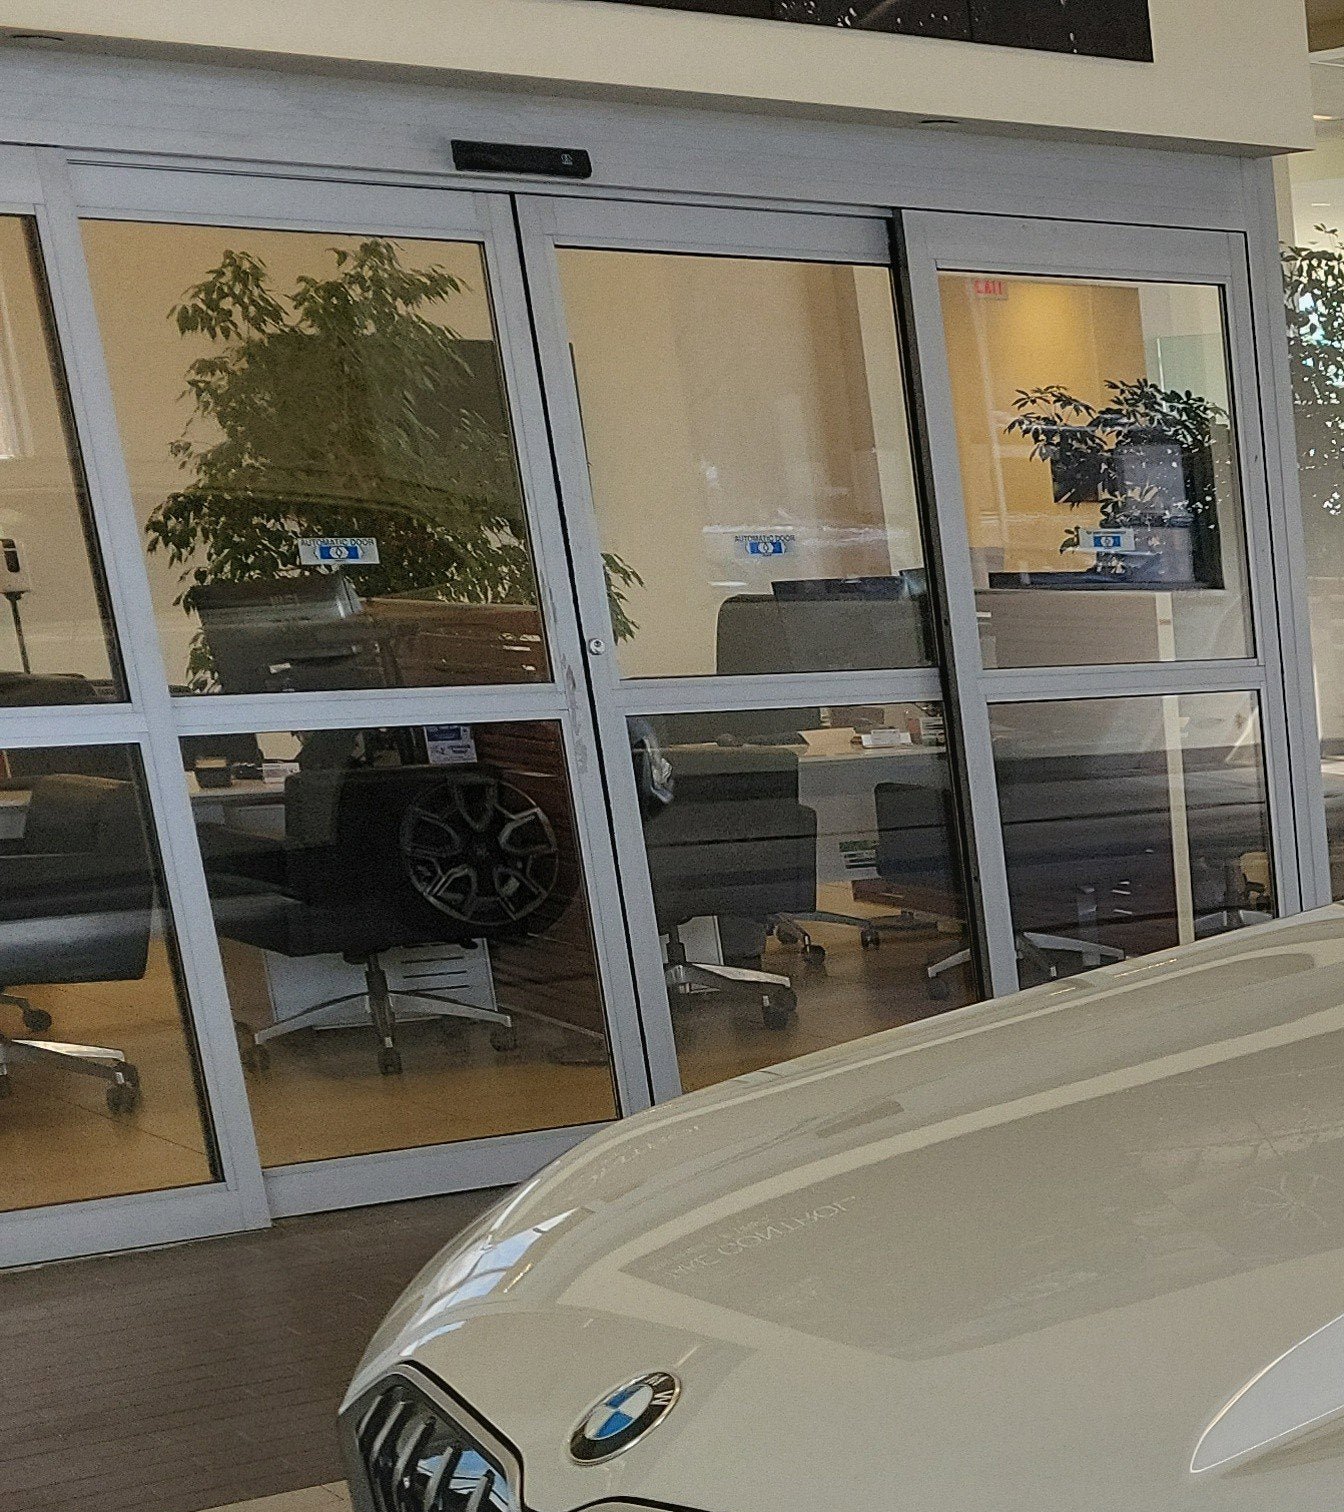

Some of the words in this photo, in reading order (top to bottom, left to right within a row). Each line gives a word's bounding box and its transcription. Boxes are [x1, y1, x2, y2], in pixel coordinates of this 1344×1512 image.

[735, 534, 774, 542] AUTOMATIC
[775, 534, 796, 542] DOOR
[301, 538, 348, 547] AUTOMATIC
[350, 538, 375, 546] DOOR
